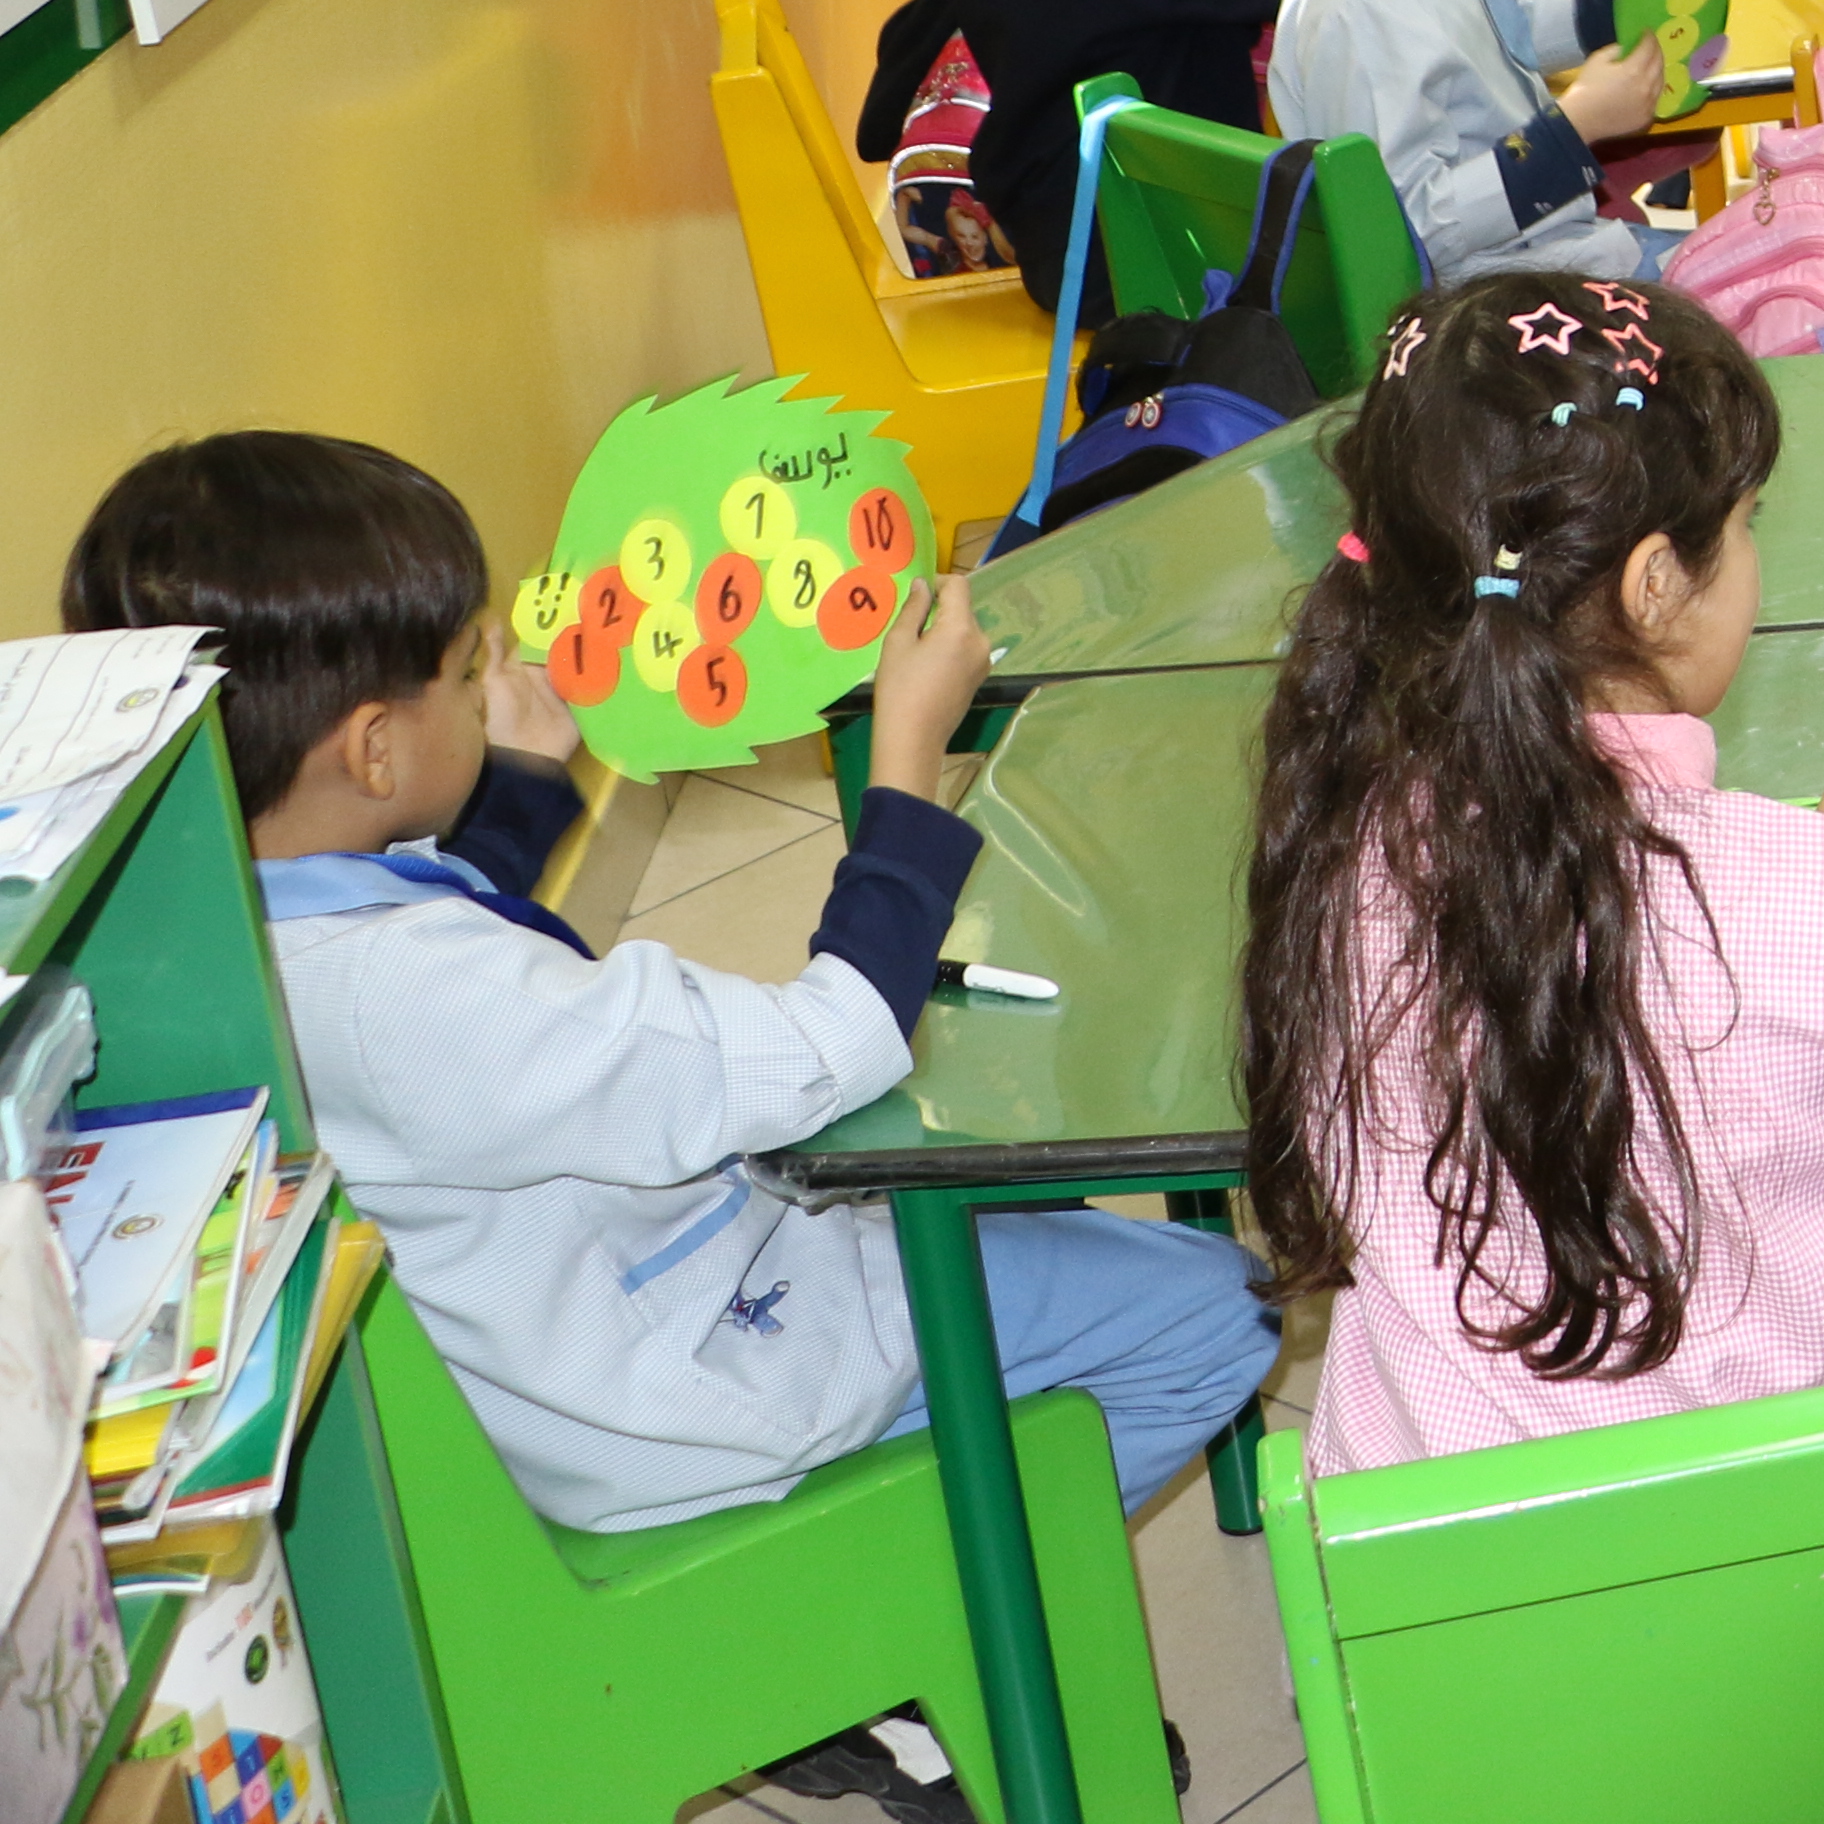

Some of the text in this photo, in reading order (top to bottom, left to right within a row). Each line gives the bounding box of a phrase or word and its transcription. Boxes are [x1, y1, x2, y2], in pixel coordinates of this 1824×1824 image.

[863, 496, 895, 552] 10
[643, 536, 664, 582] 3
[718, 574, 742, 623] 6
[793, 559, 817, 610] 8
[848, 586, 878, 613] 9
[600, 588, 622, 629] 2
[573, 633, 583, 676] 1
[652, 629, 684, 660] 4
[706, 657, 728, 708] 5
